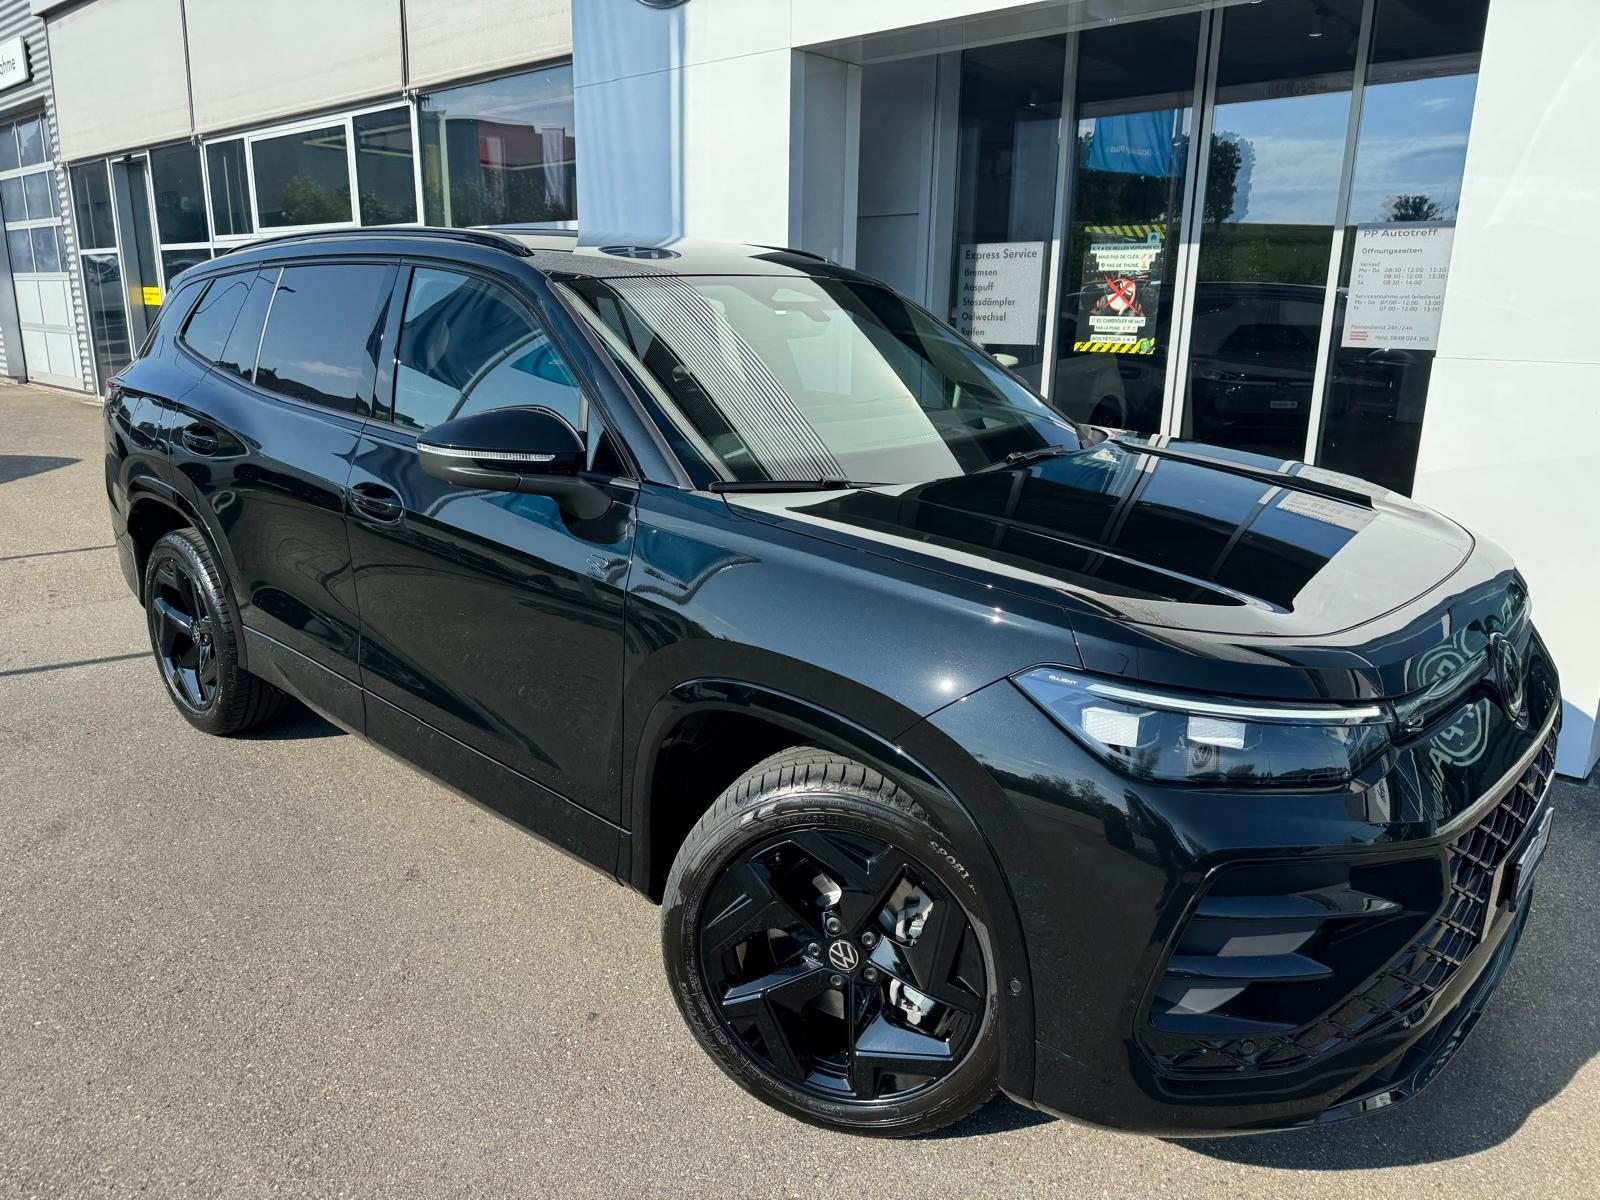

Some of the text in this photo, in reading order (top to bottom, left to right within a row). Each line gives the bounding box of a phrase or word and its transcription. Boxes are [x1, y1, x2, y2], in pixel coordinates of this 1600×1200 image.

[1364, 229, 1438, 238] PP Autotreff
[965, 248, 1037, 262] Express Service
[1361, 247, 1423, 255] Öffnungszeiten
[964, 268, 998, 277] Bremsen
[963, 282, 994, 293] Auspuff
[962, 296, 1016, 309] Stossdämpfer
[961, 312, 1007, 321] Oelwechsel
[961, 327, 985, 336] Reifen
